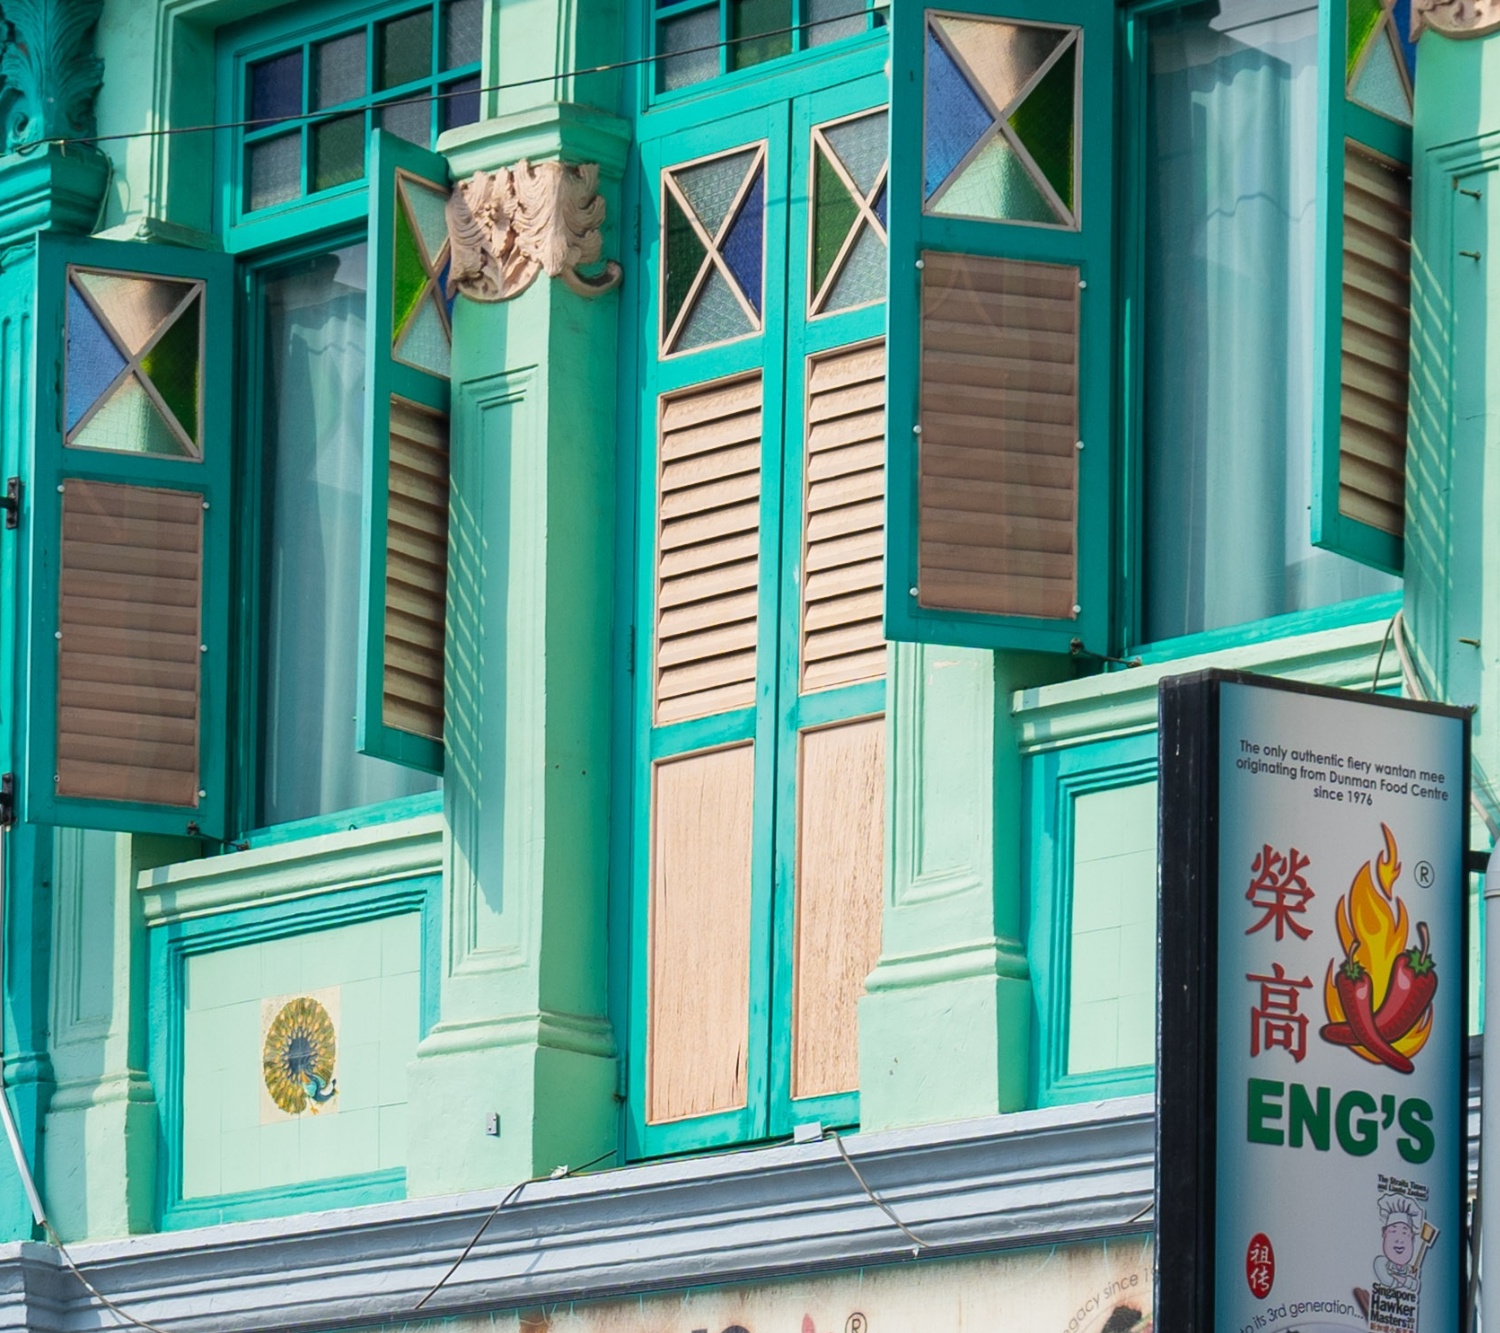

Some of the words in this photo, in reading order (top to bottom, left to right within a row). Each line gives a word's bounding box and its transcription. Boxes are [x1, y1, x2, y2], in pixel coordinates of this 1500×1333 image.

[1240, 739, 1260, 754] The
[1263, 745, 1288, 761] only
[1290, 748, 1344, 768] authentic
[1347, 756, 1371, 774] fiery
[1375, 762, 1416, 779] wantan
[1419, 770, 1445, 784] mee
[1236, 758, 1297, 779] originating
[1300, 766, 1326, 781] from
[1329, 771, 1377, 790] Dunman
[1380, 778, 1408, 795] Food
[1410, 784, 1449, 801] Centre
[1313, 786, 1344, 801] since
[1347, 790, 1373, 807] 1976
[1245, 843, 1315, 1063] 榮高
[1247, 1077, 1436, 1165] ENG'S
[1103, 1273, 1139, 1299] since
[1372, 1282, 1417, 1303] Singapore
[1252, 1314, 1267, 1328] its
[1267, 1306, 1287, 1323] 3rd
[1371, 1294, 1416, 1317] Hawker
[1370, 1310, 1407, 1328] Masters
